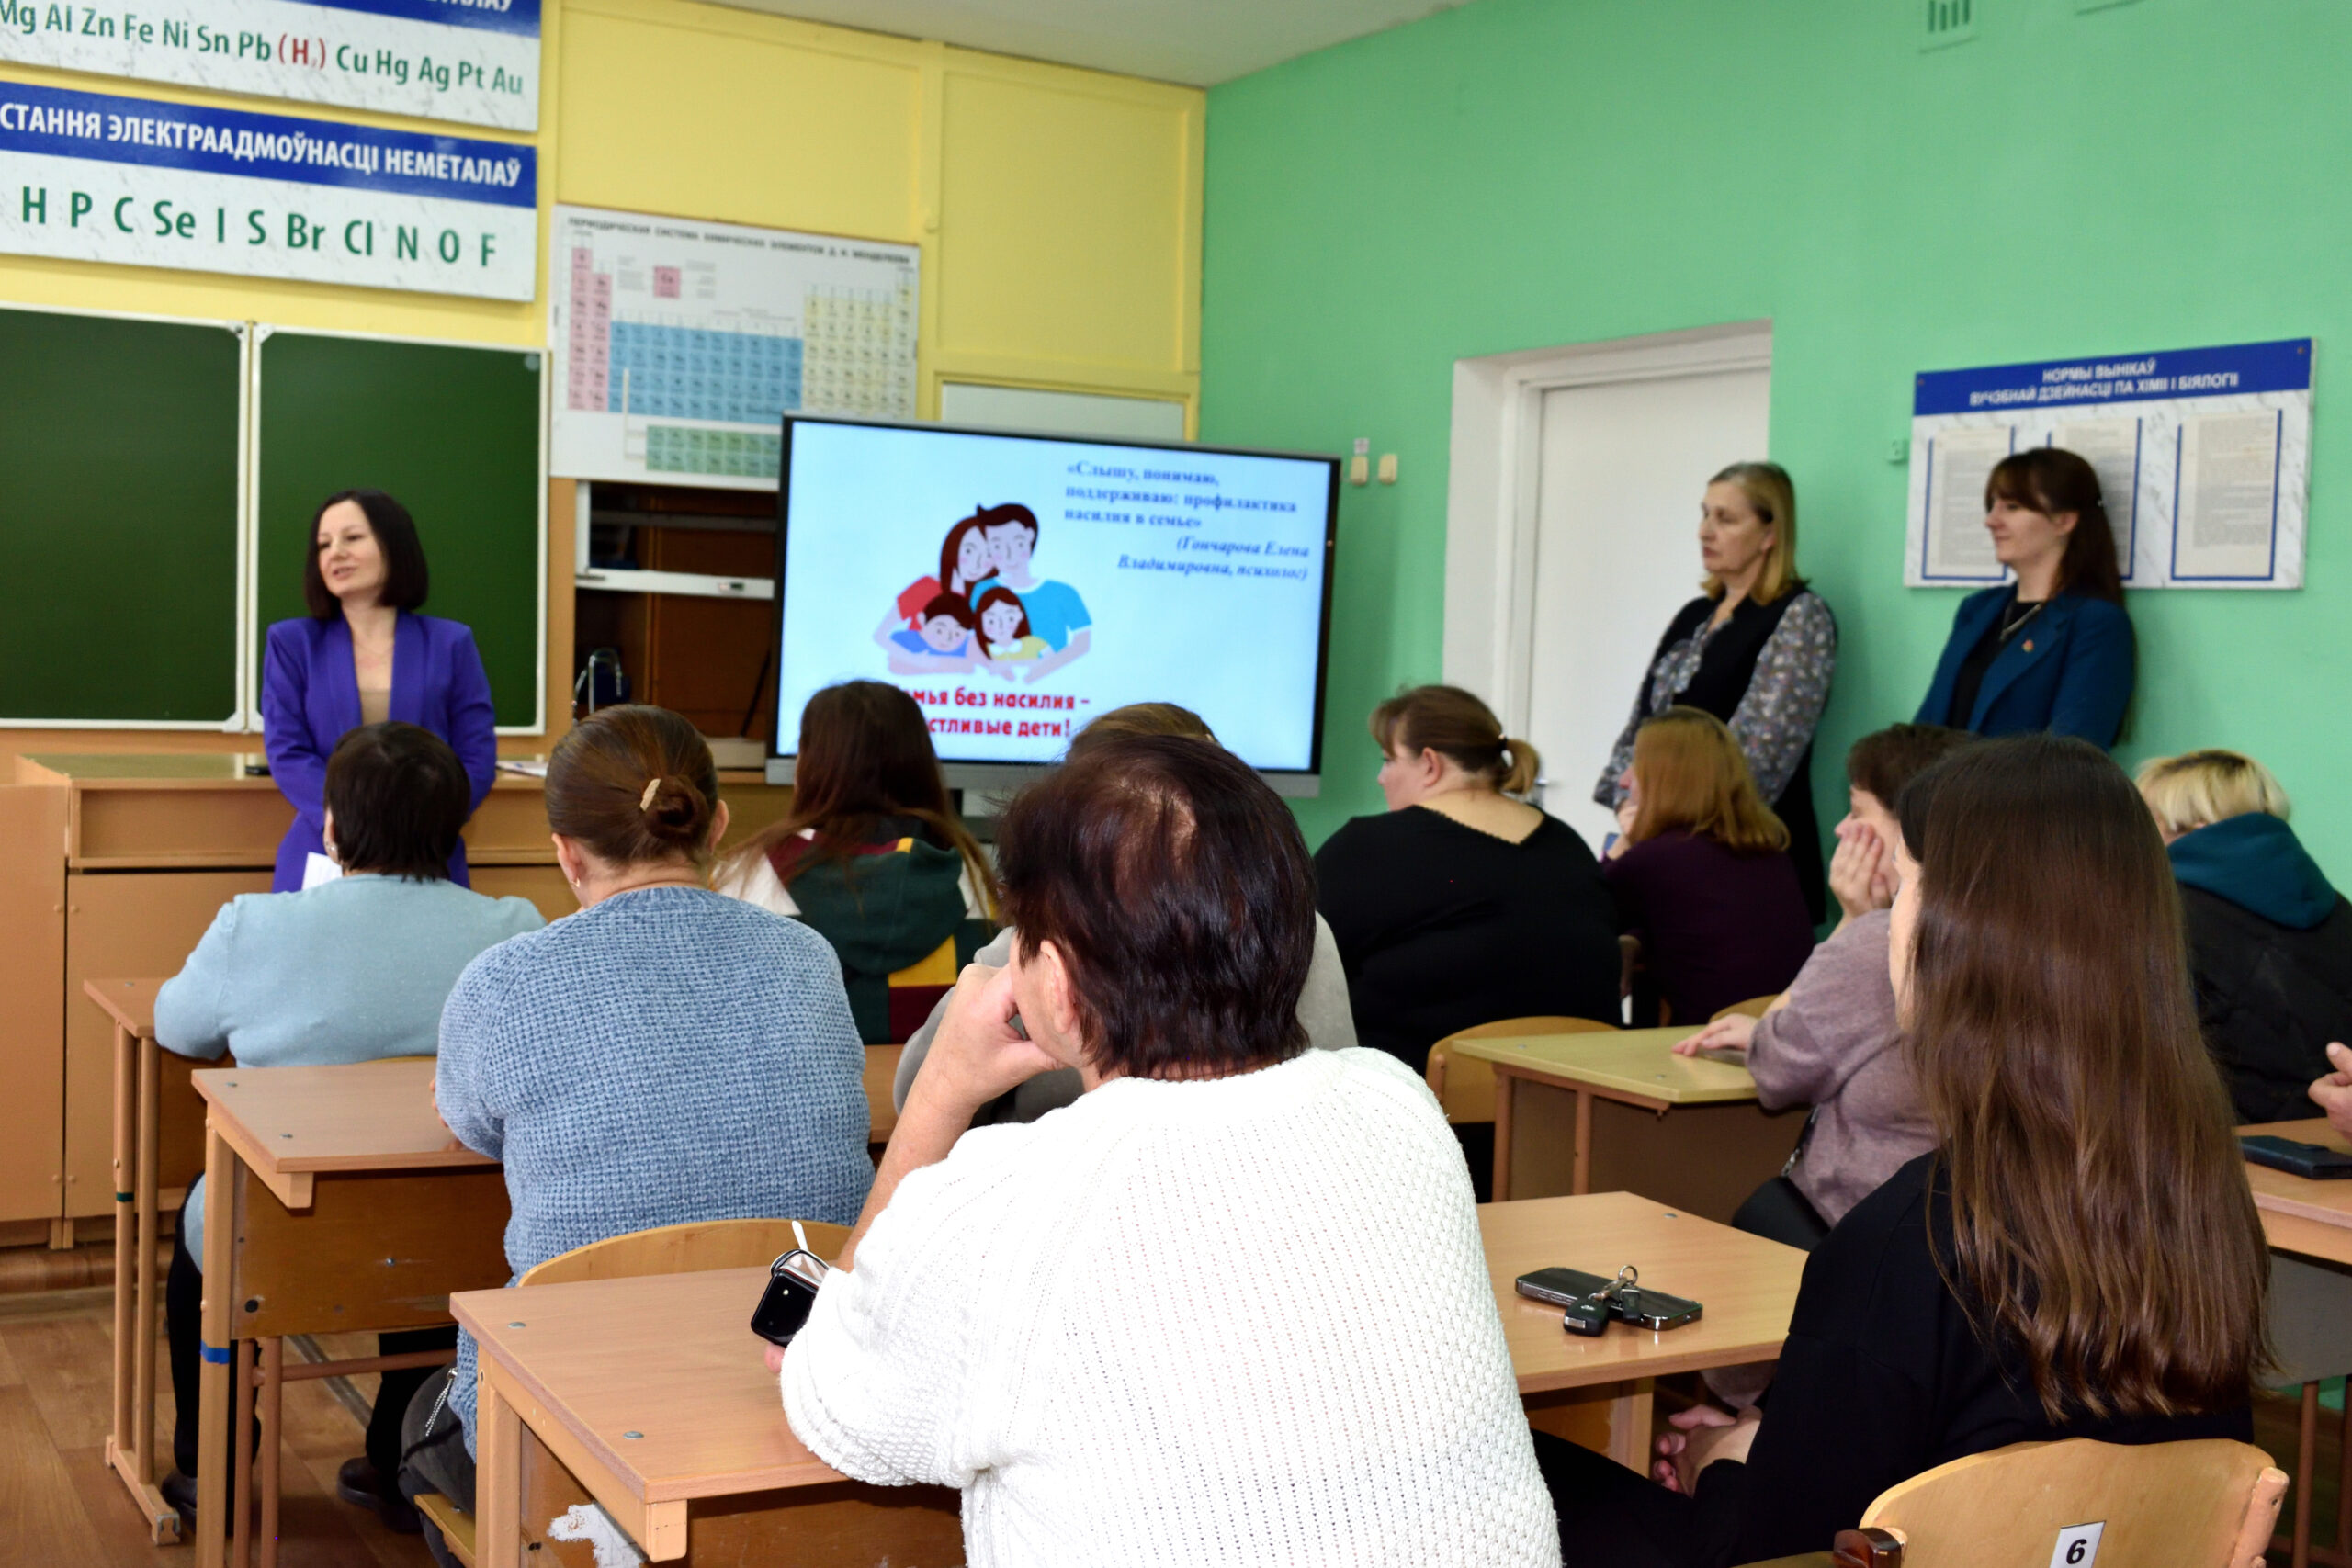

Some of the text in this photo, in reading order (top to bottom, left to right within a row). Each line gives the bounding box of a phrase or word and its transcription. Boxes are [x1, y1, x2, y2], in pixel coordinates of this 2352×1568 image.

[0, 0, 36, 34] Mg
[45, 3, 72, 32] Al
[82, 7, 115, 38] Zn
[124, 13, 153, 43] Fe
[164, 19, 188, 48] Ni
[198, 25, 229, 53] Sn
[239, 31, 271, 61] Pb
[336, 45, 368, 73] Cu
[377, 49, 408, 85] Hg
[419, 56, 449, 92] Ag
[458, 62, 483, 89] Pt
[492, 67, 523, 94] Au
[107, 114, 379, 175] ЭЛЕКТРААДМОЎНАСЦІ
[385, 147, 521, 187] НЕМЕТАЛАЎ
[23, 186, 46, 224] H
[72, 192, 93, 227] P
[114, 197, 134, 233] C
[153, 200, 196, 238] Se
[248, 210, 266, 244] S
[288, 213, 325, 251] Br
[345, 220, 372, 255] Cl
[398, 226, 417, 261] N
[439, 229, 459, 264] O
[481, 233, 495, 266] F
[2042, 356, 2156, 383] НОРМЫ ВЫНІКАЎ
[2115, 379, 2135, 395] ПА
[1143, 468, 1219, 487] понимаю,
[1066, 486, 1297, 513] поддерживаю: профилактика
[1065, 508, 1201, 528] насилия в семье»
[1176, 536, 1310, 557] (Гончарова Елена
[1118, 554, 1308, 581] Владимировна, психолог)
[904, 689, 947, 705] мья
[956, 686, 986, 706] без
[994, 693, 1074, 710] насилия
[928, 718, 1069, 737] стливые дети!
[2066, 1539, 2087, 1564] 6
